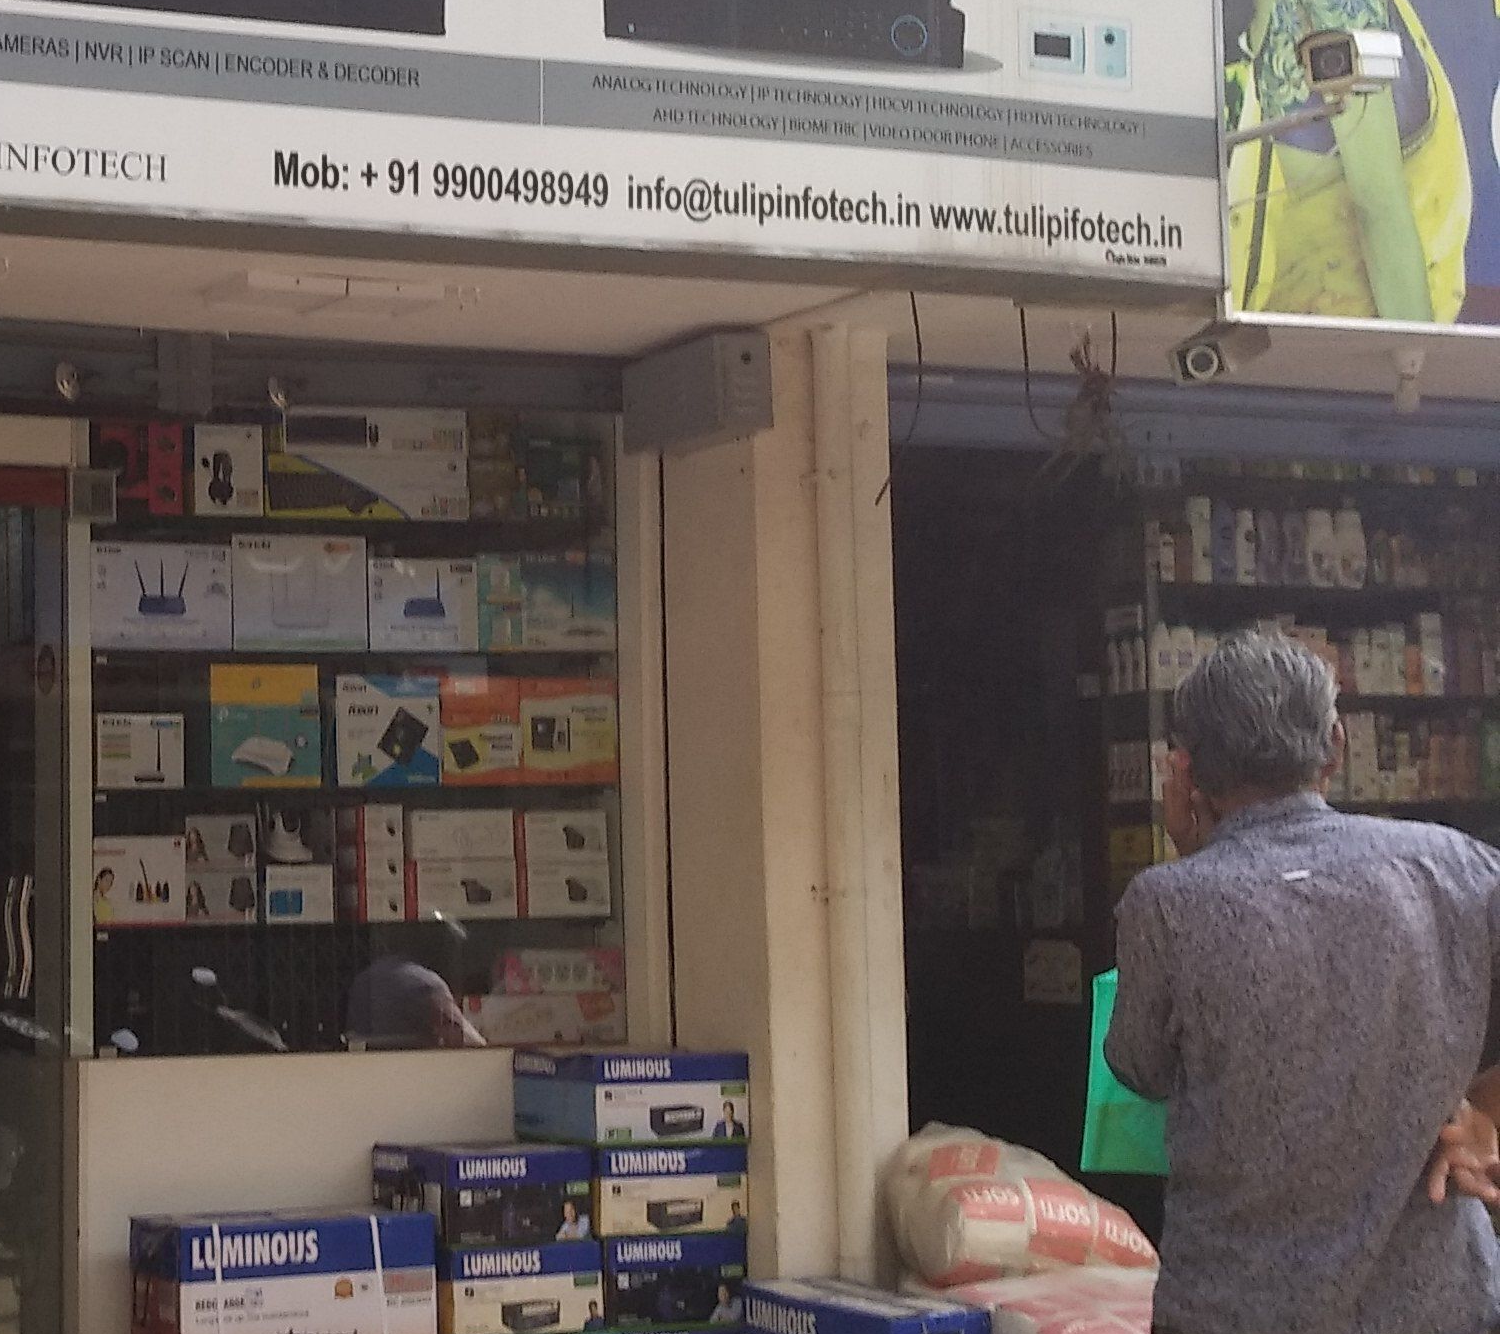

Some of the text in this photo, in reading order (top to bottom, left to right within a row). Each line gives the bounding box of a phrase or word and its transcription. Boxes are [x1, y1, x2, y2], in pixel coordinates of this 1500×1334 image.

[84, 40, 123, 63] NVR
[138, 45, 155, 64] IP
[160, 47, 211, 71] SCAN
[225, 52, 314, 81] ENCODER
[333, 62, 421, 89] DECODER
[592, 74, 651, 93] ANALOG
[656, 78, 747, 100] TECHNOLOGY
[273, 150, 350, 192] Mob:
[388, 159, 421, 196] 91
[433, 162, 609, 209] 9900498949
[626, 175, 921, 229] info@tulipinfotech.in
[930, 201, 1183, 249] www.tulipifotech.in
[603, 1058, 671, 1080] LUMINOUS
[458, 1156, 527, 1180] LUMINOUS
[610, 1151, 686, 1175] LUMINOUS
[191, 1229, 319, 1271] LUMINOUS
[617, 1239, 682, 1262] LUMINOUS
[463, 1250, 540, 1277] LUMINOUS
